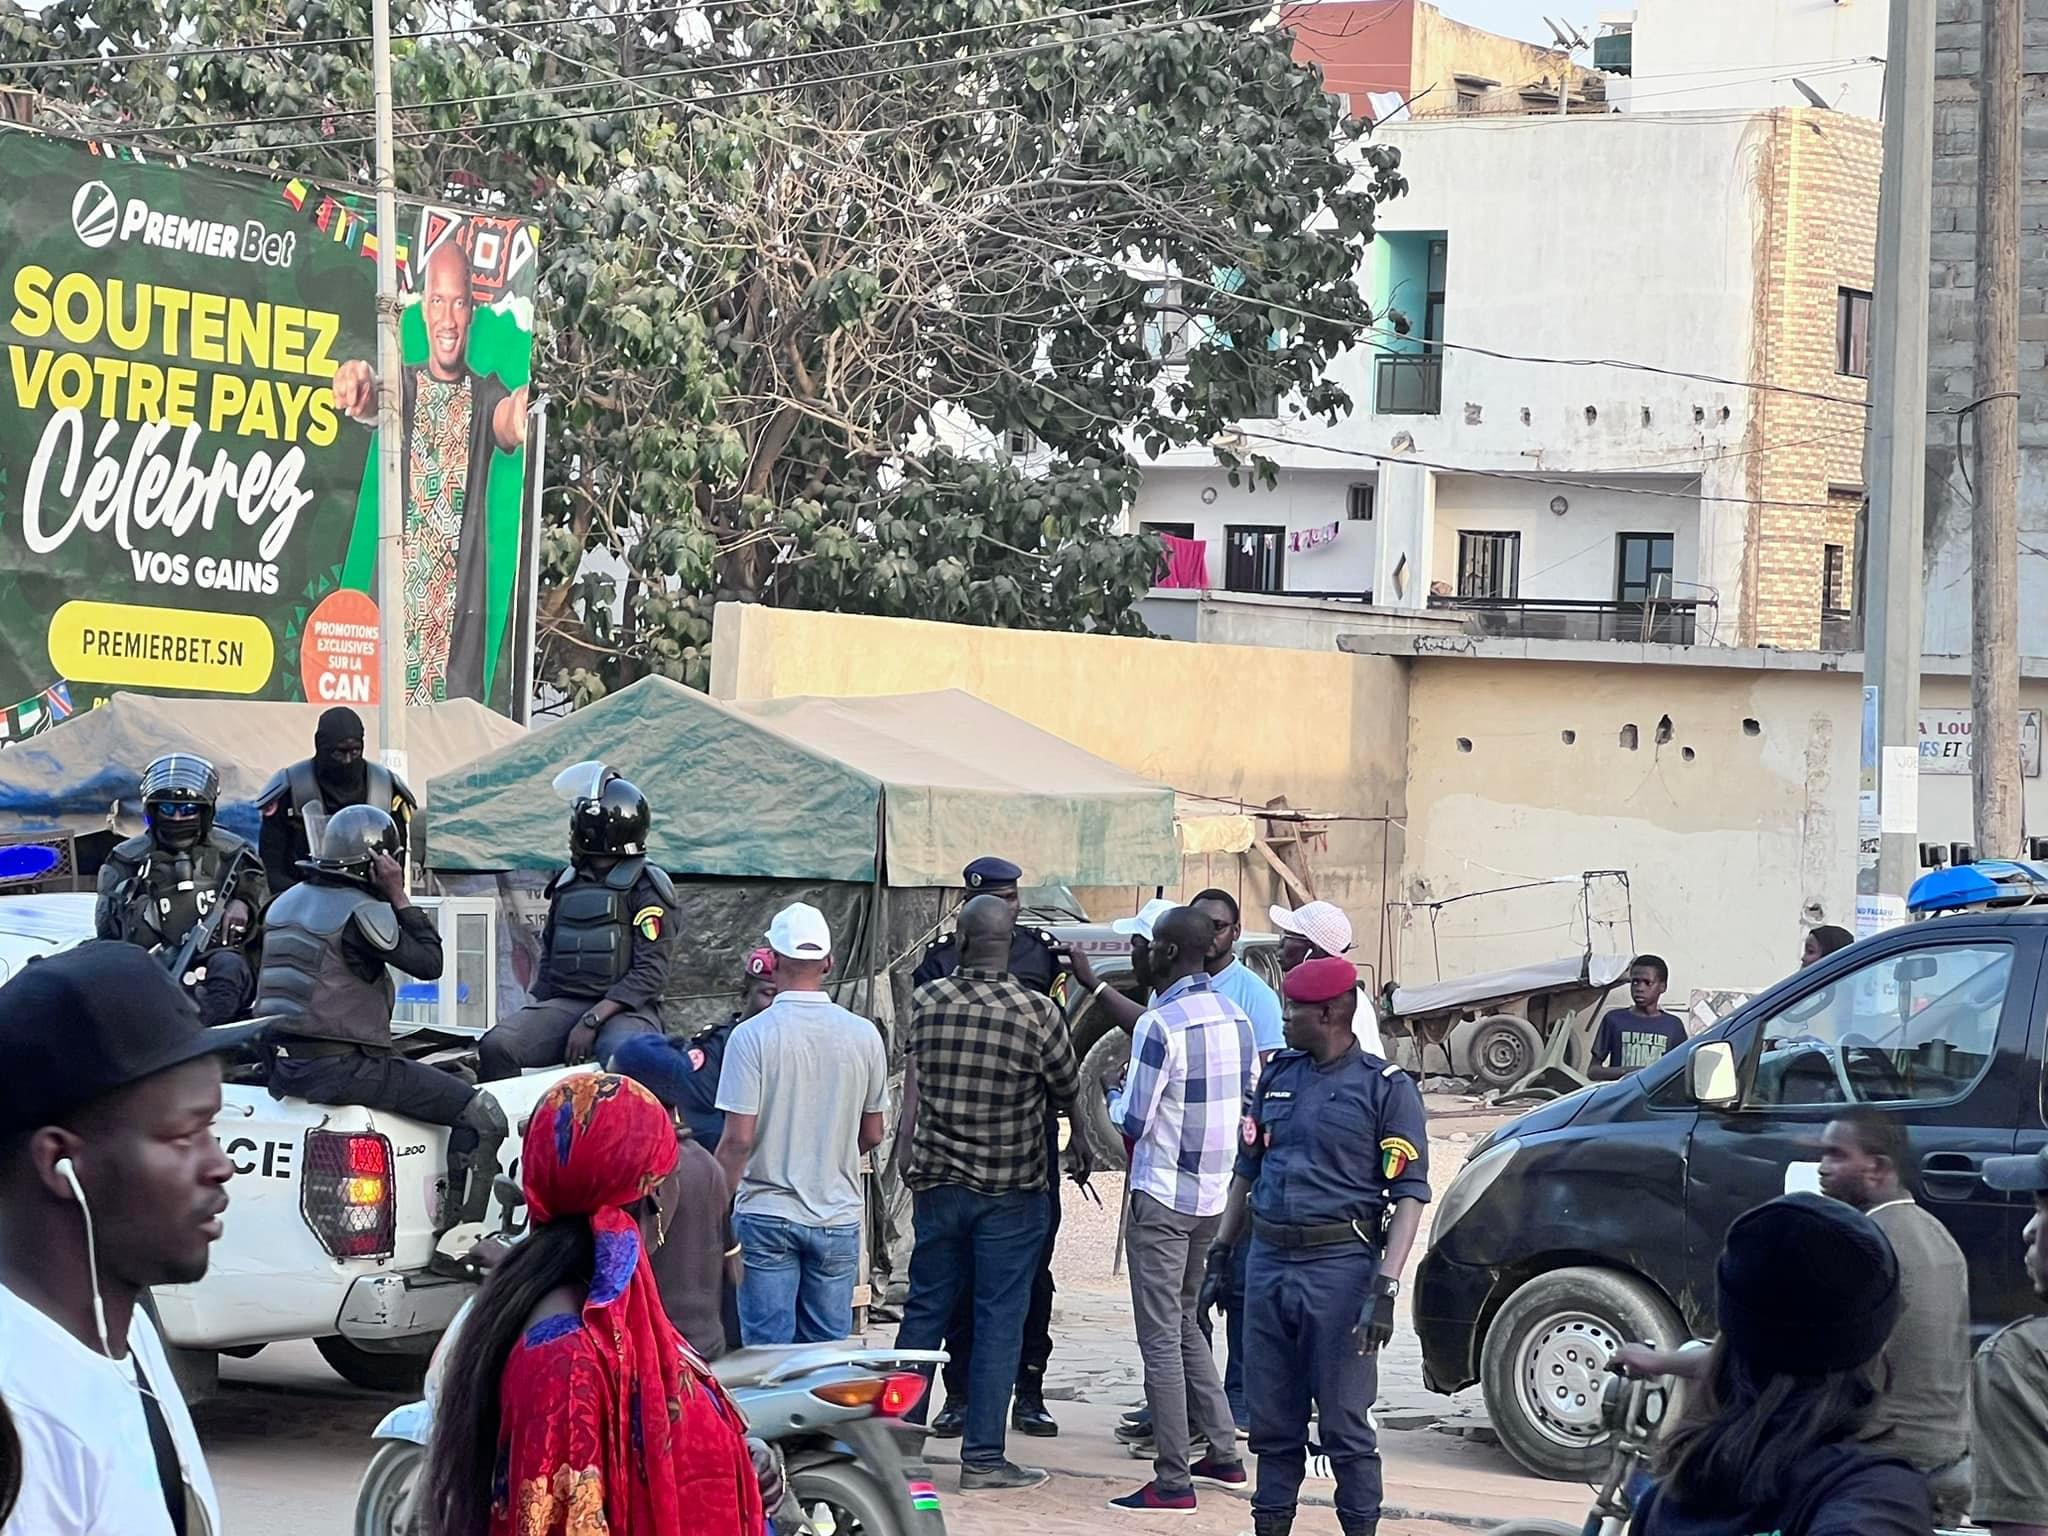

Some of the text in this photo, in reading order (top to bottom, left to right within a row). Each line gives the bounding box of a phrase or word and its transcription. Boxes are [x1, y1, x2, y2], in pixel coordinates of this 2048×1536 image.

[119, 199, 296, 267] PREMIER Bet
[10, 265, 340, 378] SOUTENEZ
[8, 345, 339, 447] VOTRE PAYS
[22, 405, 314, 562] Célébrez
[131, 548, 280, 595] VOS GAINS
[82, 628, 244, 667] PREMIERBET.SN
[314, 620, 380, 640] PROMOTIONS
[317, 638, 375, 656] EXCLUSIVES
[328, 655, 362, 671] SUR LA
[318, 671, 370, 702] CAN
[1943, 741, 1962, 757] ET
[397, 1143, 426, 1157] L200
